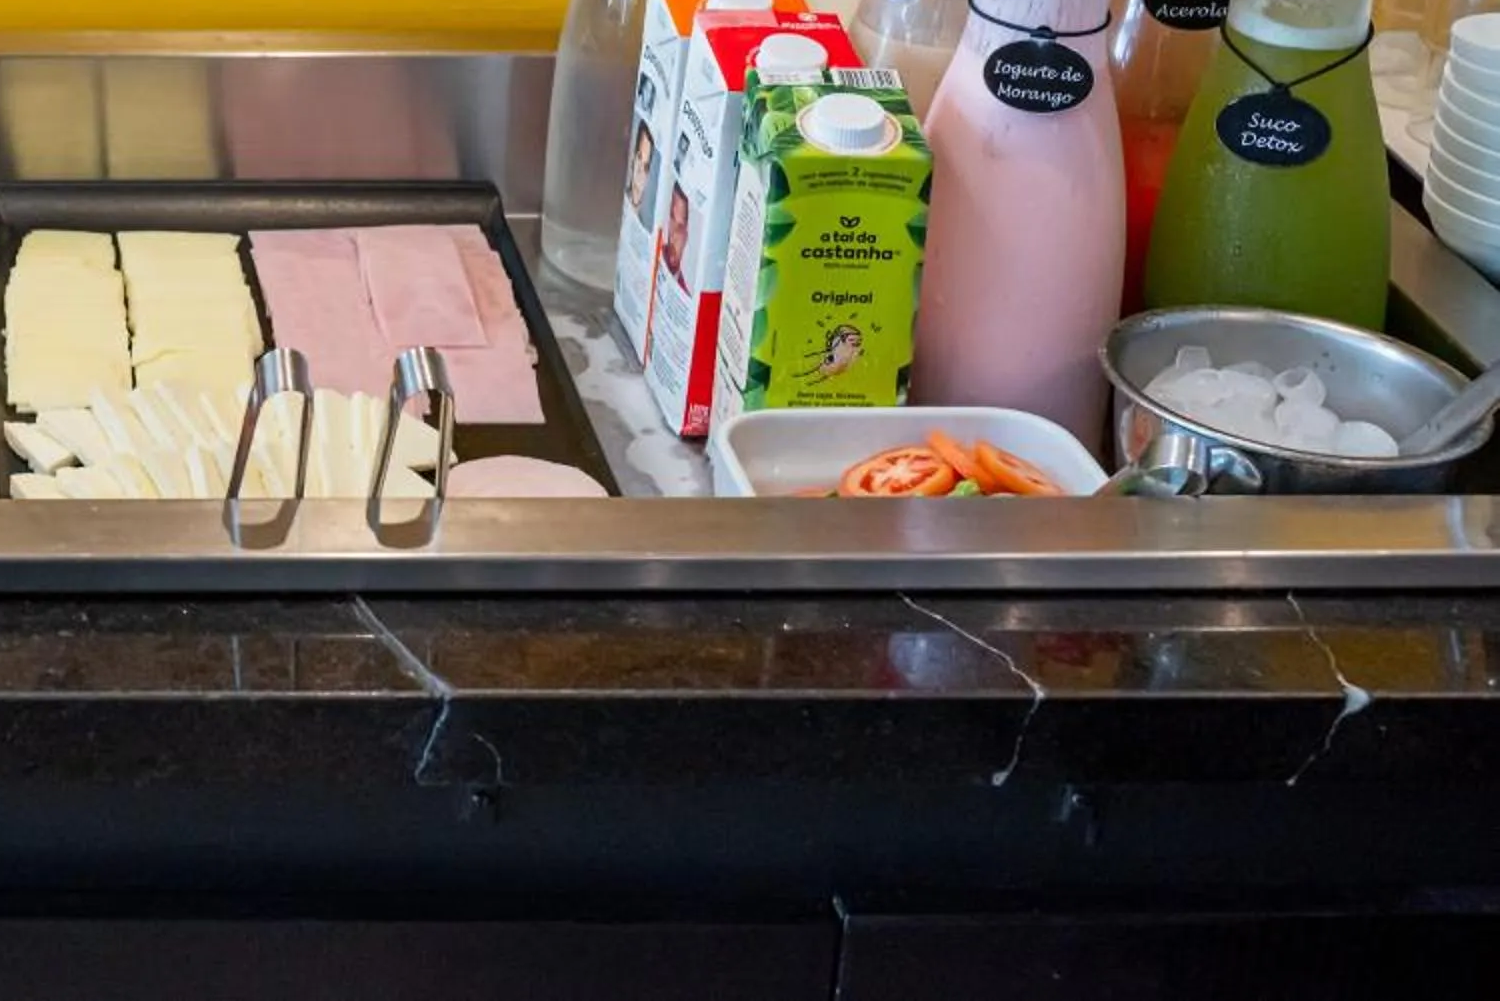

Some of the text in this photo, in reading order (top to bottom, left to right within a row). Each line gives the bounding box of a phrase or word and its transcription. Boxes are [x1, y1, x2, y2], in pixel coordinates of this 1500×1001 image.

[1155, 2, 1227, 18] Acerola
[993, 59, 1084, 82] Iogurte de
[997, 82, 1076, 108] Morango
[1247, 112, 1301, 133] Suco
[1241, 131, 1305, 154] Detox
[857, 231, 877, 245] da
[801, 245, 893, 261] castanha
[811, 289, 874, 306] Original
